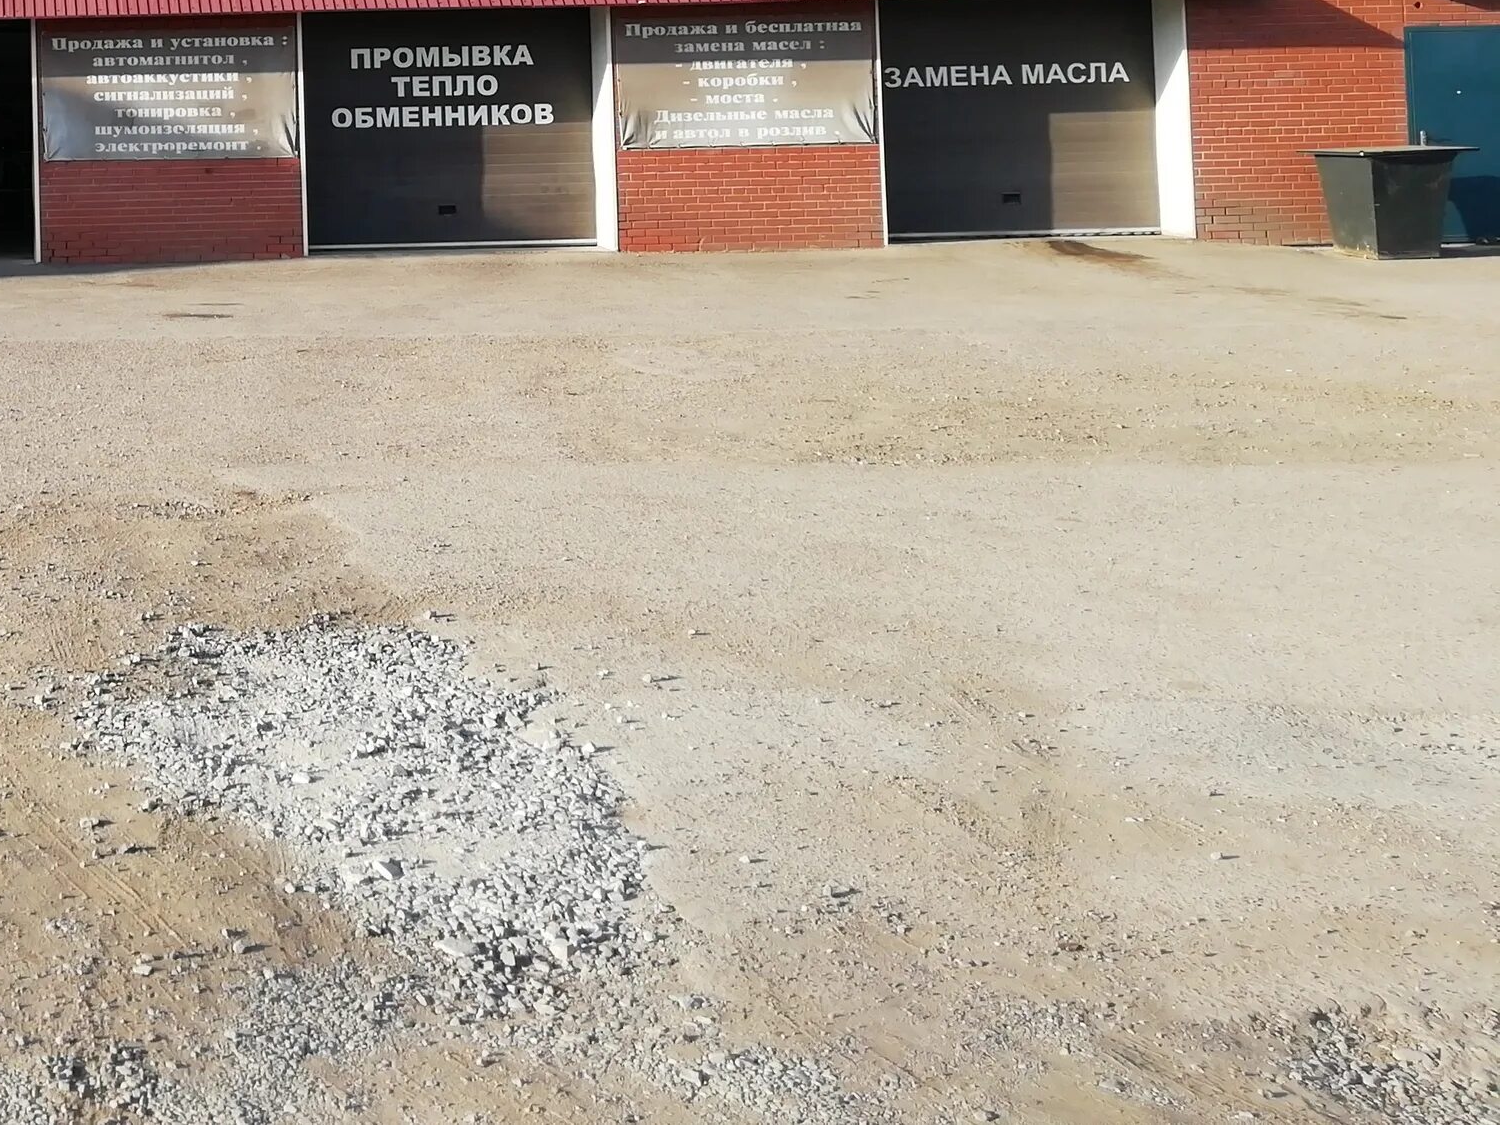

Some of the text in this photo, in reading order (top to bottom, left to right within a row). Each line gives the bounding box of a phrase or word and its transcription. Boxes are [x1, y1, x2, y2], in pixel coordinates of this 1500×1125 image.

[625, 20, 862, 39] Продажа и бесплатная
[52, 37, 143, 52] Продажа
[151, 37, 163, 48] и
[170, 35, 274, 51] установка
[674, 41, 744, 53] замена
[752, 39, 811, 51] масел
[92, 54, 235, 67] автомагнитол
[350, 44, 534, 69] ПРОМЫВКА
[689, 59, 793, 71] двигателя
[86, 72, 239, 85] автоаккустики
[698, 73, 784, 89] коробки
[884, 62, 1130, 88] ЗАМЕНА МАСЛА
[391, 75, 499, 97] ТЕПЛО
[93, 87, 235, 102] сигнализаций
[705, 92, 765, 104] моста
[114, 106, 222, 120] тонировка
[331, 103, 554, 129] ОБМЕННИКОВ
[654, 107, 834, 125] Дизельные масла
[95, 123, 245, 138] шумоизоляция
[654, 128, 667, 140] и
[673, 127, 731, 139] автол
[738, 128, 749, 138] в
[757, 125, 826, 140] розлив
[95, 139, 249, 155] электроремонт
